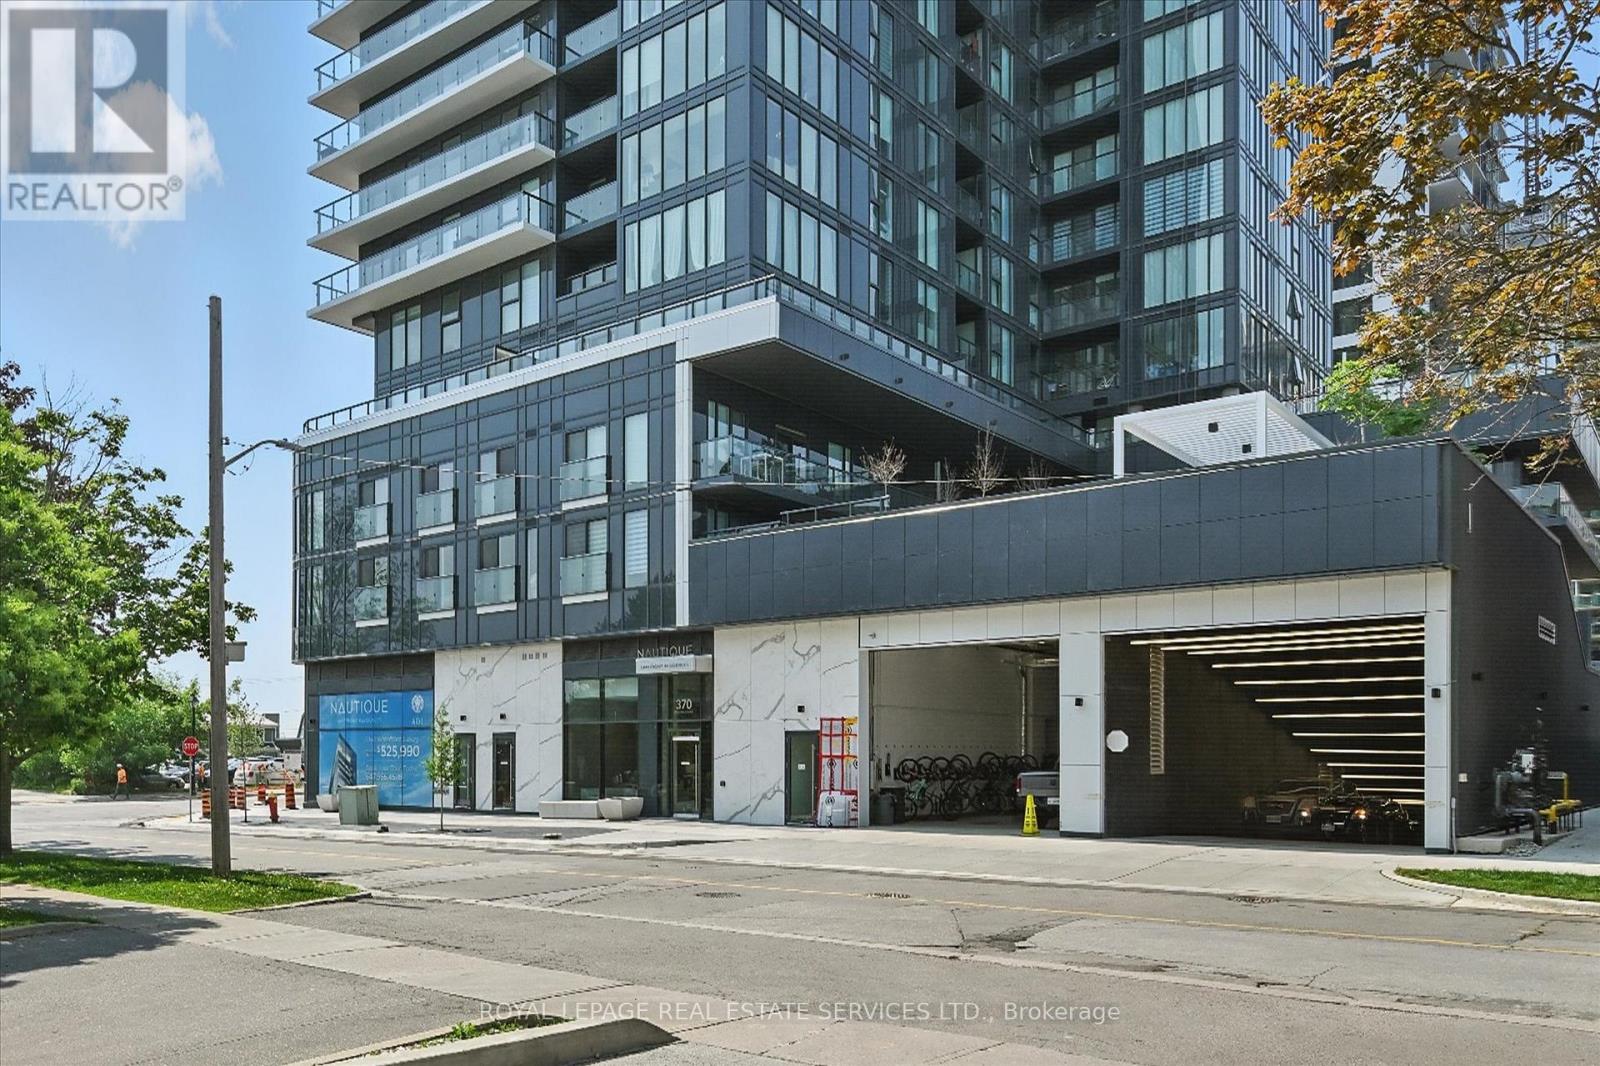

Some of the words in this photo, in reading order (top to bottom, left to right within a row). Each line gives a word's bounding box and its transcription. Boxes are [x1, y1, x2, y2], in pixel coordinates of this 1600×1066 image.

[636, 644, 694, 658] NAUTIQUE
[330, 699, 389, 715] NAUTIQUE
[675, 698, 693, 710] 370
[184, 742, 198, 750] STOP
[376, 744, 420, 759] $525,990
